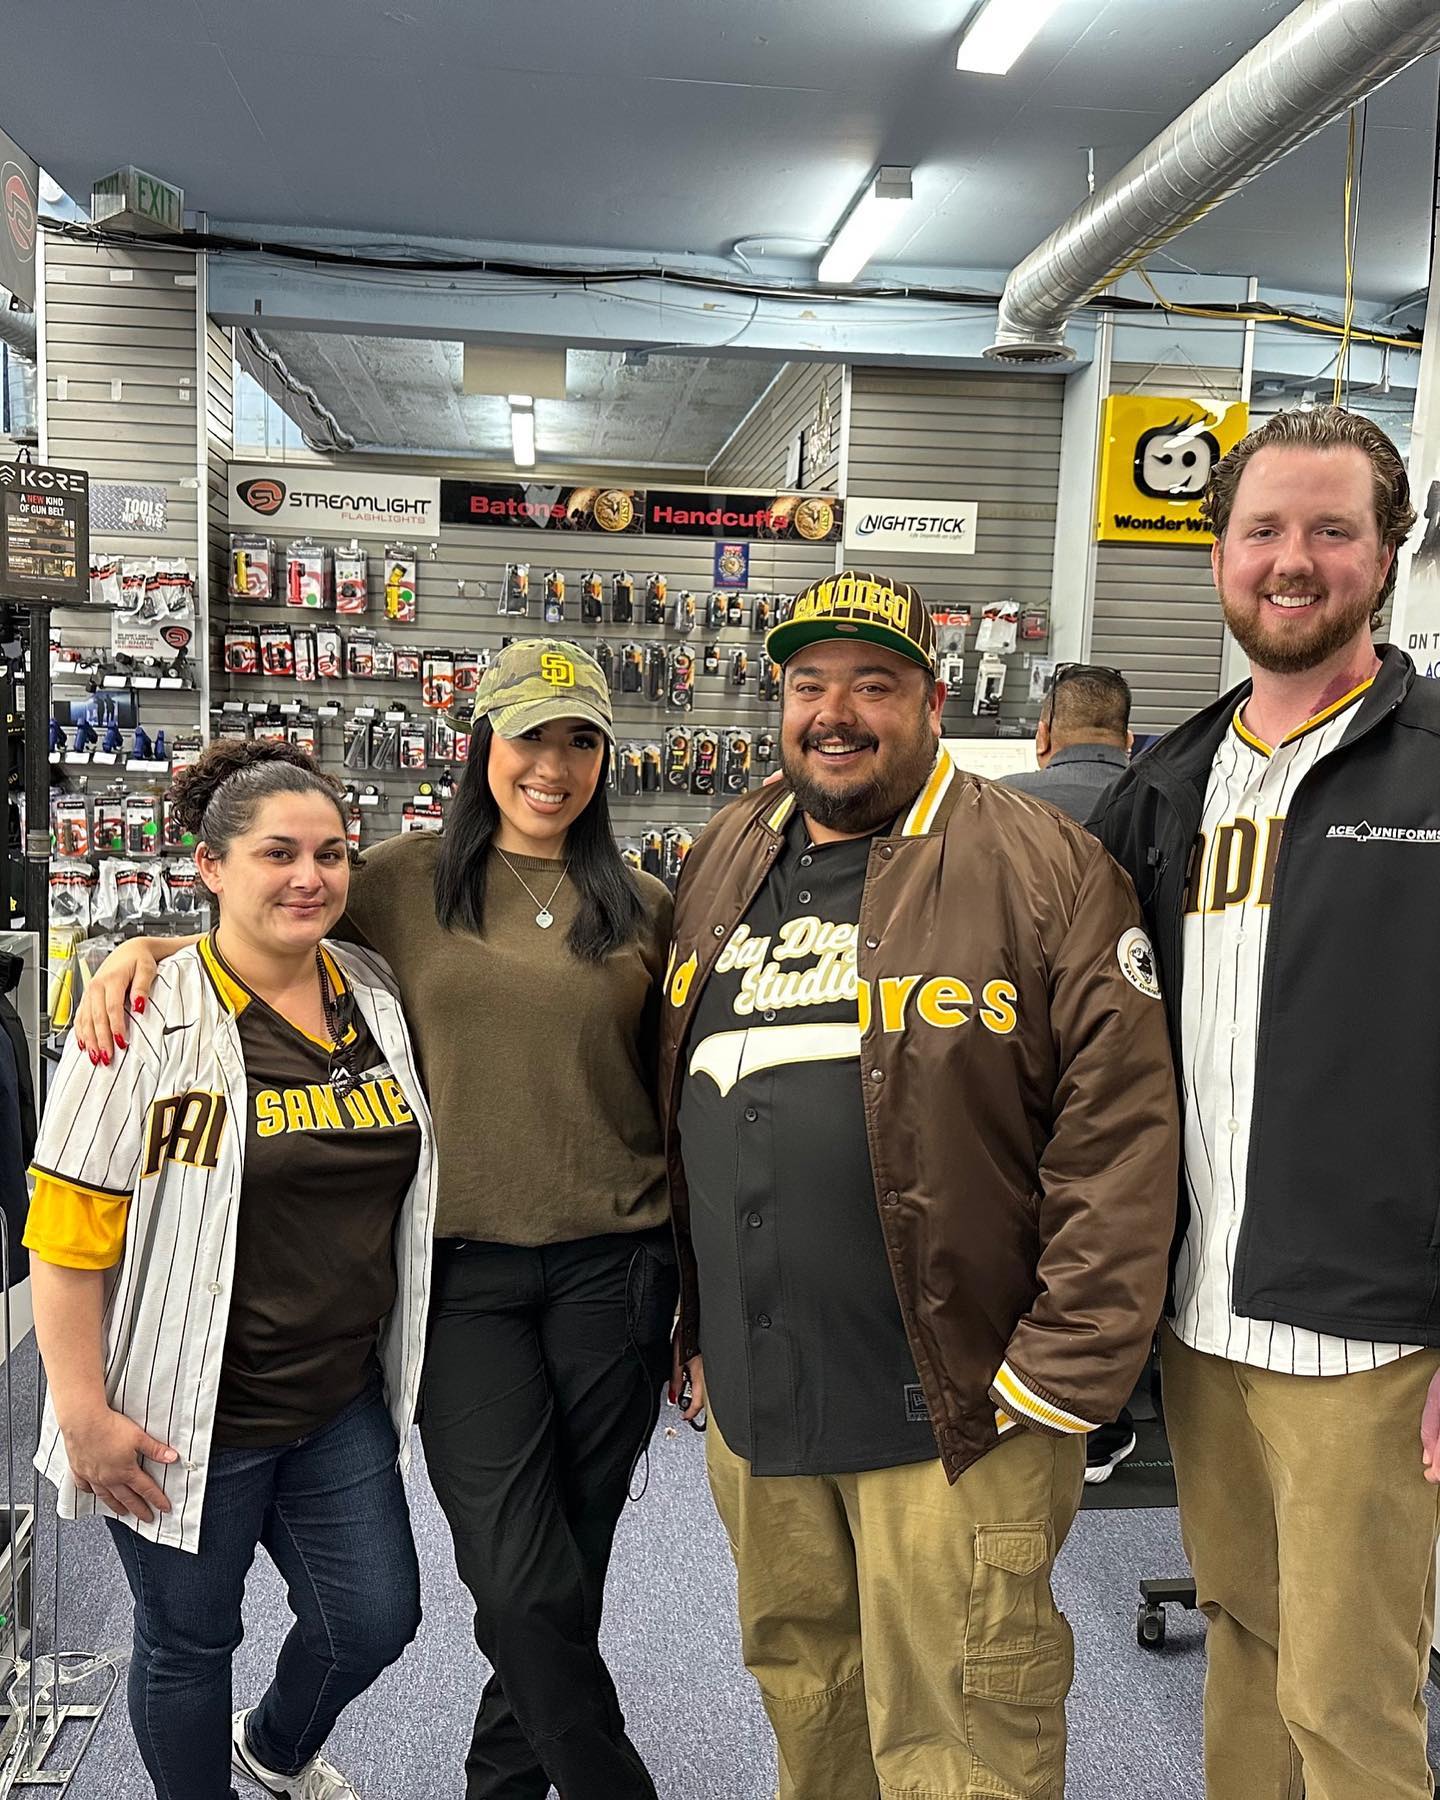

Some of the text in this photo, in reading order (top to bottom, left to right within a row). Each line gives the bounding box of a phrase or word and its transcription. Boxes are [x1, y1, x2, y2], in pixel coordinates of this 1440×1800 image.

[138, 176, 176, 224] EXIT
[20, 468, 85, 493] KORE
[20, 494, 64, 507] A NEW KIND
[20, 504, 65, 517] OF GUN BELT
[122, 497, 164, 518] TOOLS
[289, 492, 431, 514] STREAMLIGHT
[470, 495, 568, 518] Batons
[341, 511, 426, 525] FLASHLIGHTS
[653, 505, 789, 529] Handcuffs
[864, 514, 966, 534] NIGHTSTICK
[793, 578, 909, 630] SAN DIEGO
[1408, 633, 1428, 650] ON
[540, 652, 575, 689] SD
[1327, 825, 1355, 836] ACE
[256, 1083, 346, 1137] SAN
